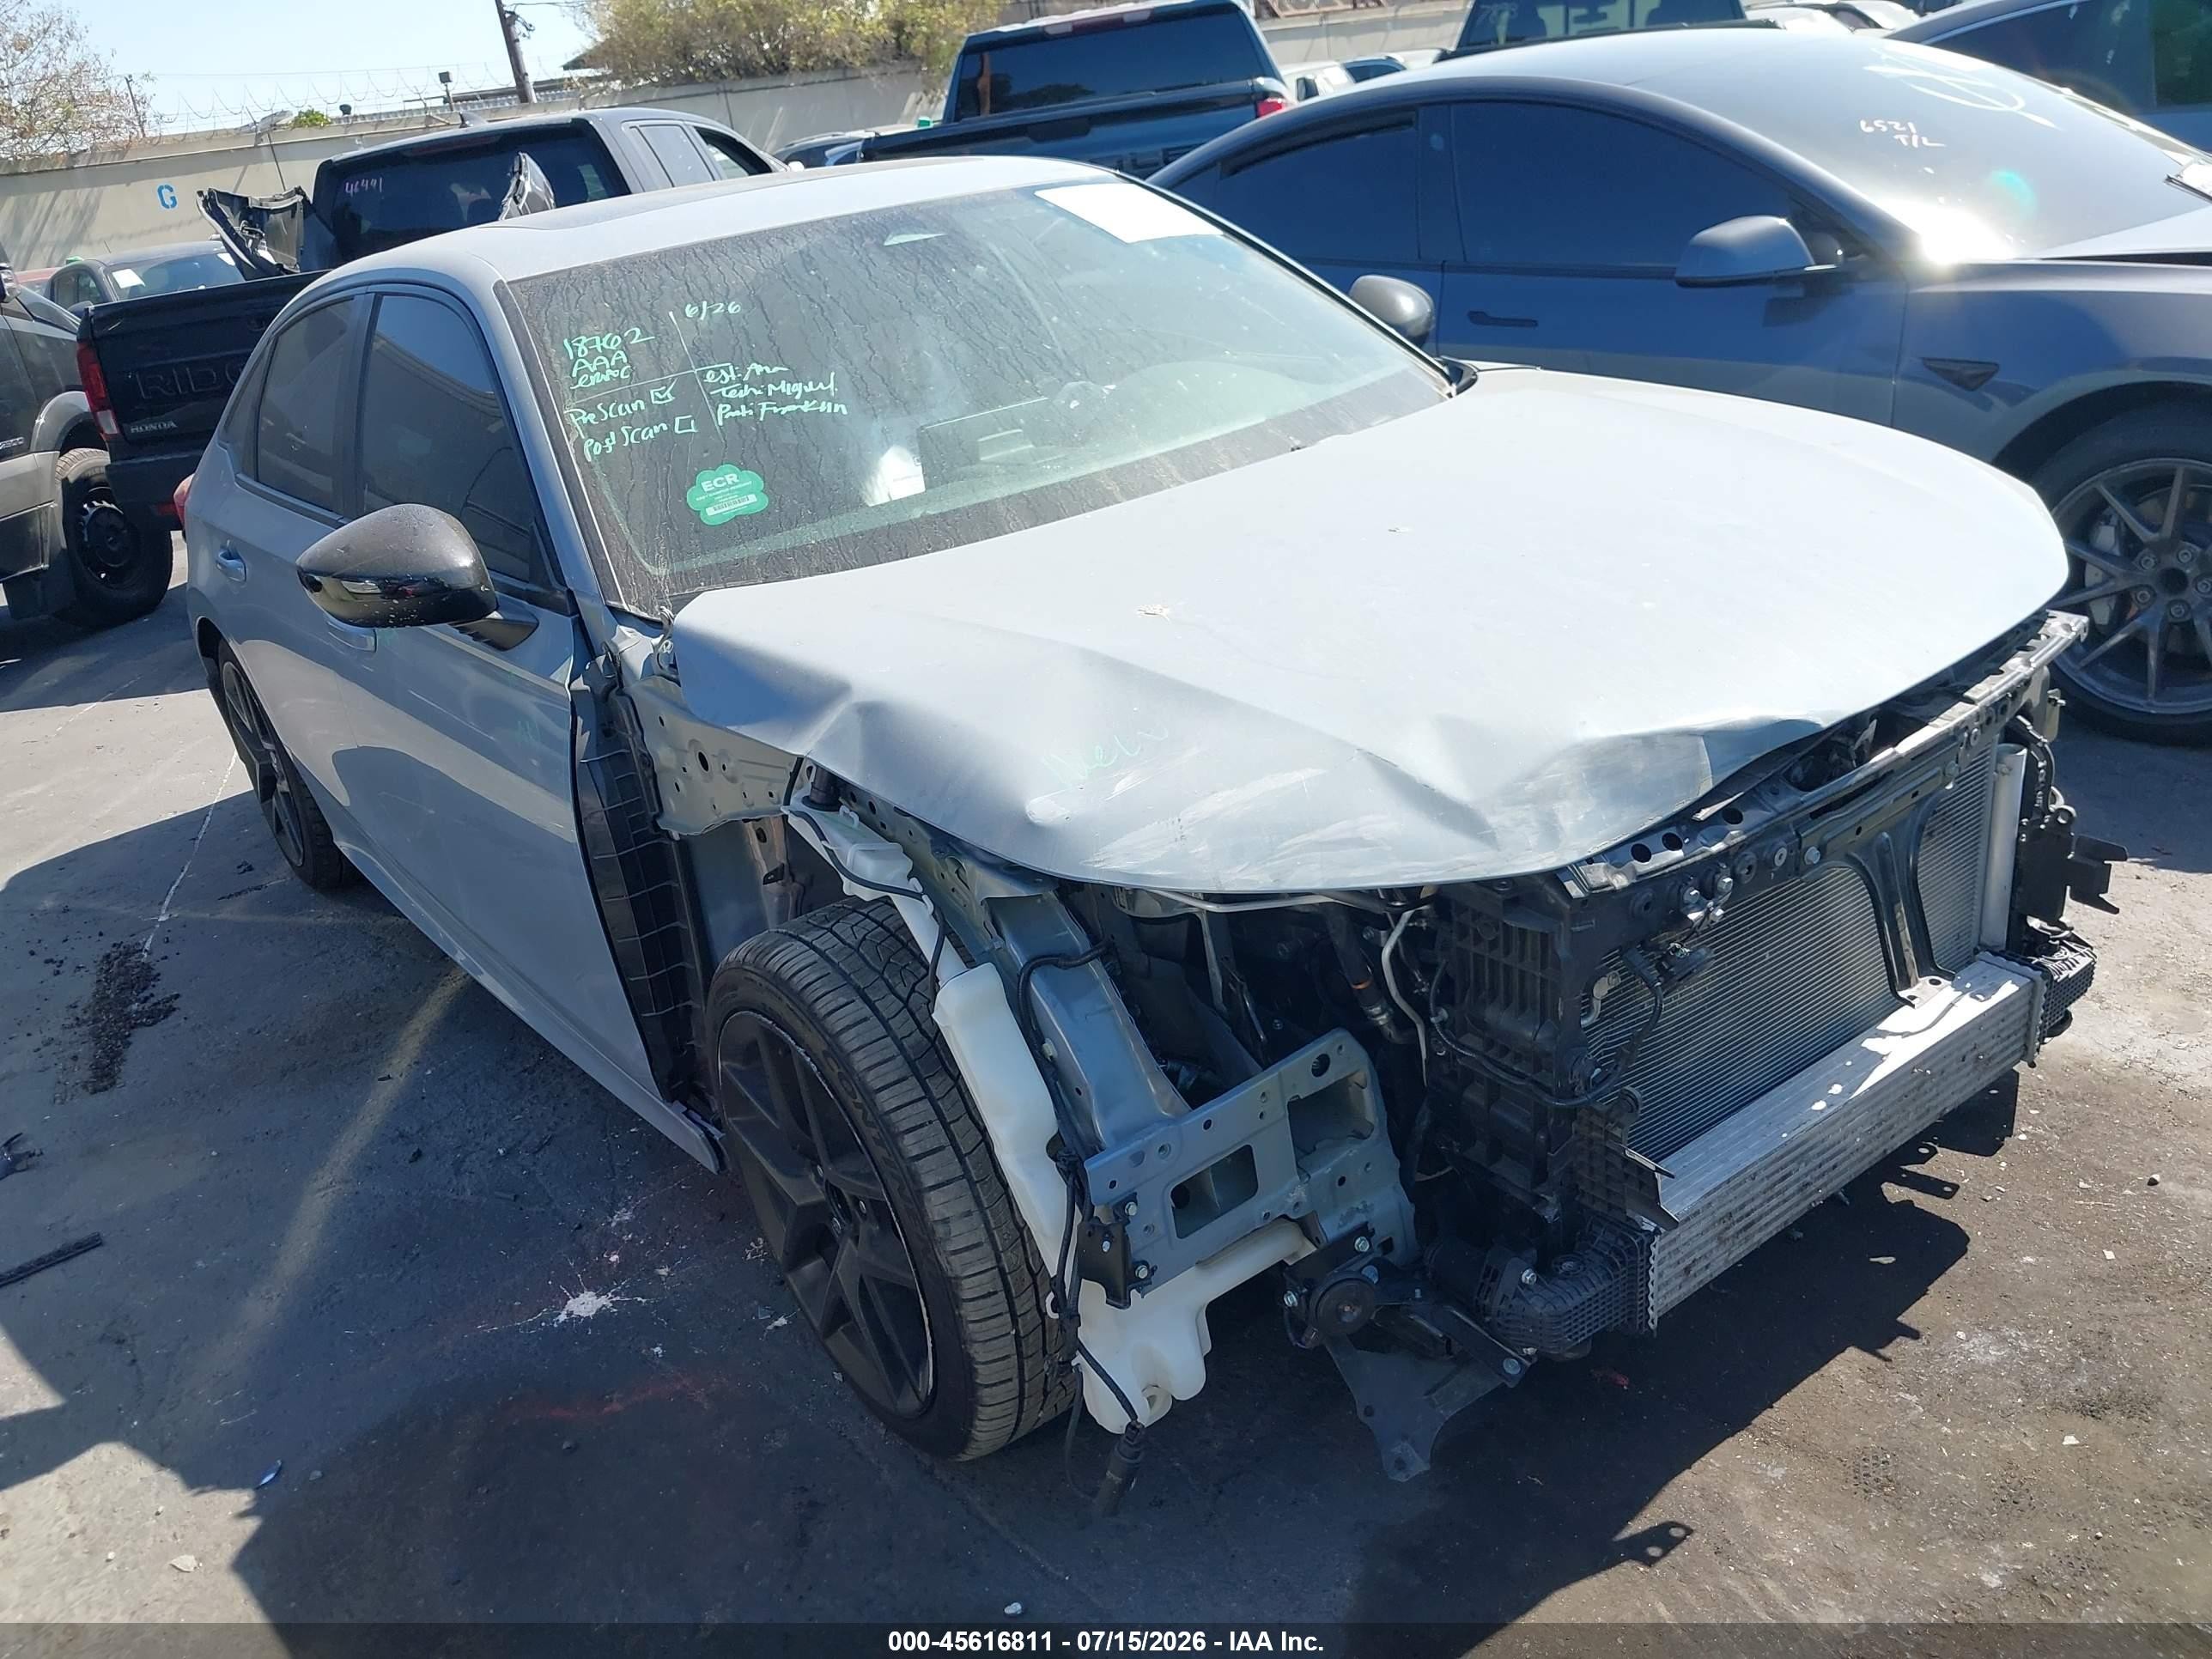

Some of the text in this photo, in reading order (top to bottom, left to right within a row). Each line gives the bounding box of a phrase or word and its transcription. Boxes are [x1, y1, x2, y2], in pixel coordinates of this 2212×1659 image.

[684, 301, 742, 320] 6/26
[571, 349, 628, 377] AAA
[131, 420, 178, 434] HONDA
[701, 473, 739, 492] ECR
